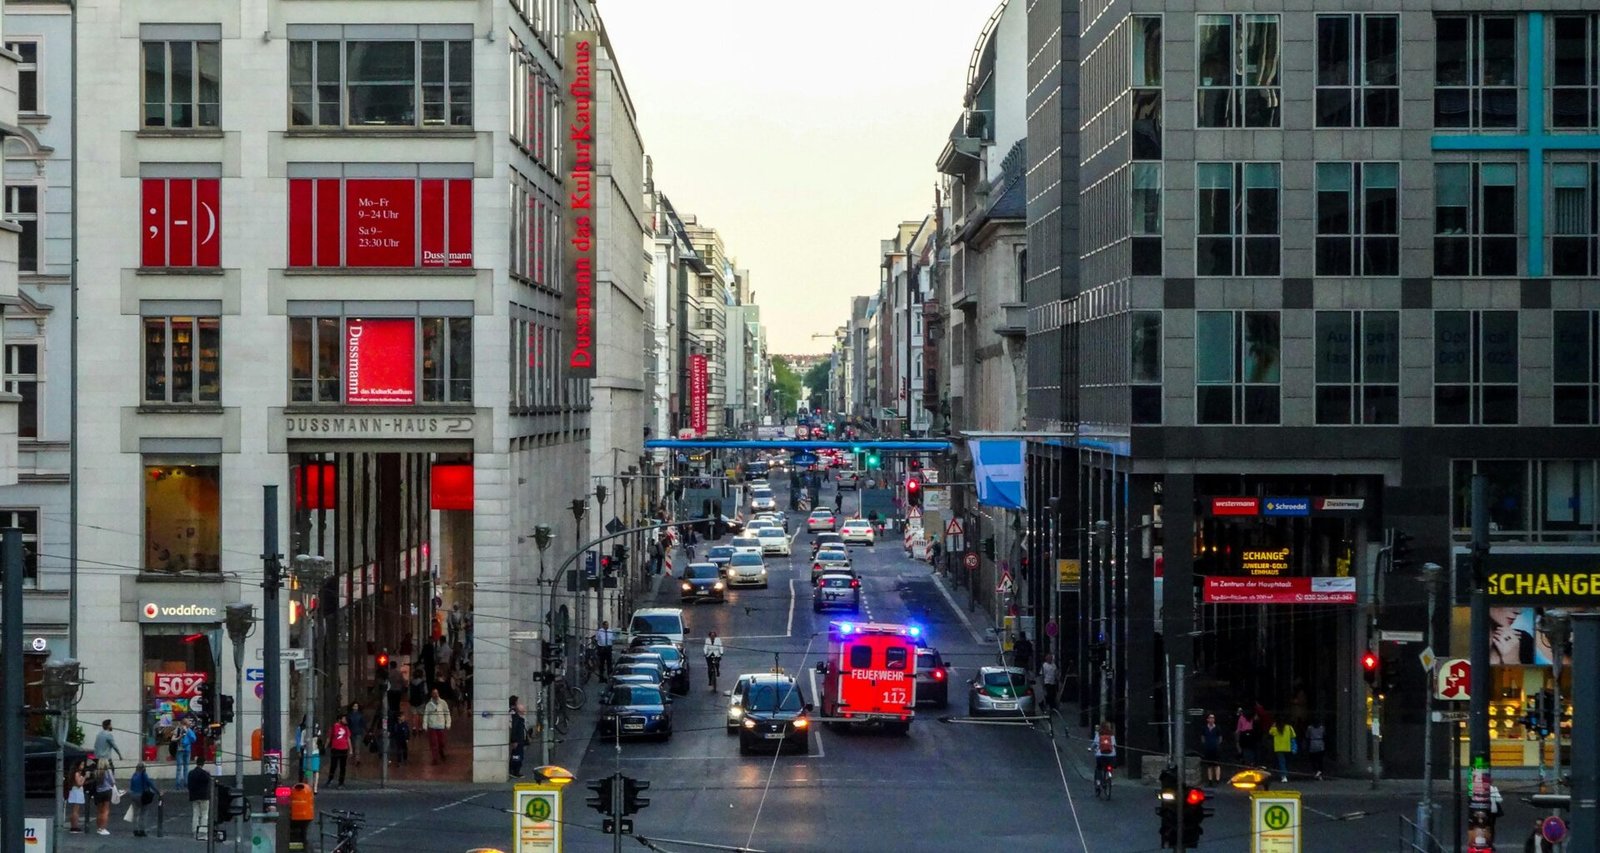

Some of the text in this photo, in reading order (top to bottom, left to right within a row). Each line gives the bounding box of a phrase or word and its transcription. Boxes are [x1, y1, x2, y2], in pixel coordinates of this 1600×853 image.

[570, 40, 592, 369] Dussmann das KulturKaufhaus
[383, 209, 399, 219] Uhr
[358, 226, 370, 235] Sa
[358, 238, 400, 248] 23:30 Uhr
[423, 250, 472, 259] Dussmann
[349, 326, 363, 395] Dussmann
[286, 418, 438, 433] DUSSMANN-HAUS
[1215, 500, 1255, 508] westermann
[1275, 502, 1307, 511] Schroedel
[1326, 500, 1360, 509] Diesterweg
[1210, 580, 1219, 588] Im
[1220, 580, 1245, 588] Zentrum
[1246, 580, 1257, 588] der
[161, 604, 217, 616] vodafone
[851, 669, 904, 681] FEUERWEHR
[158, 676, 203, 695] 50%
[882, 691, 906, 704] 112
